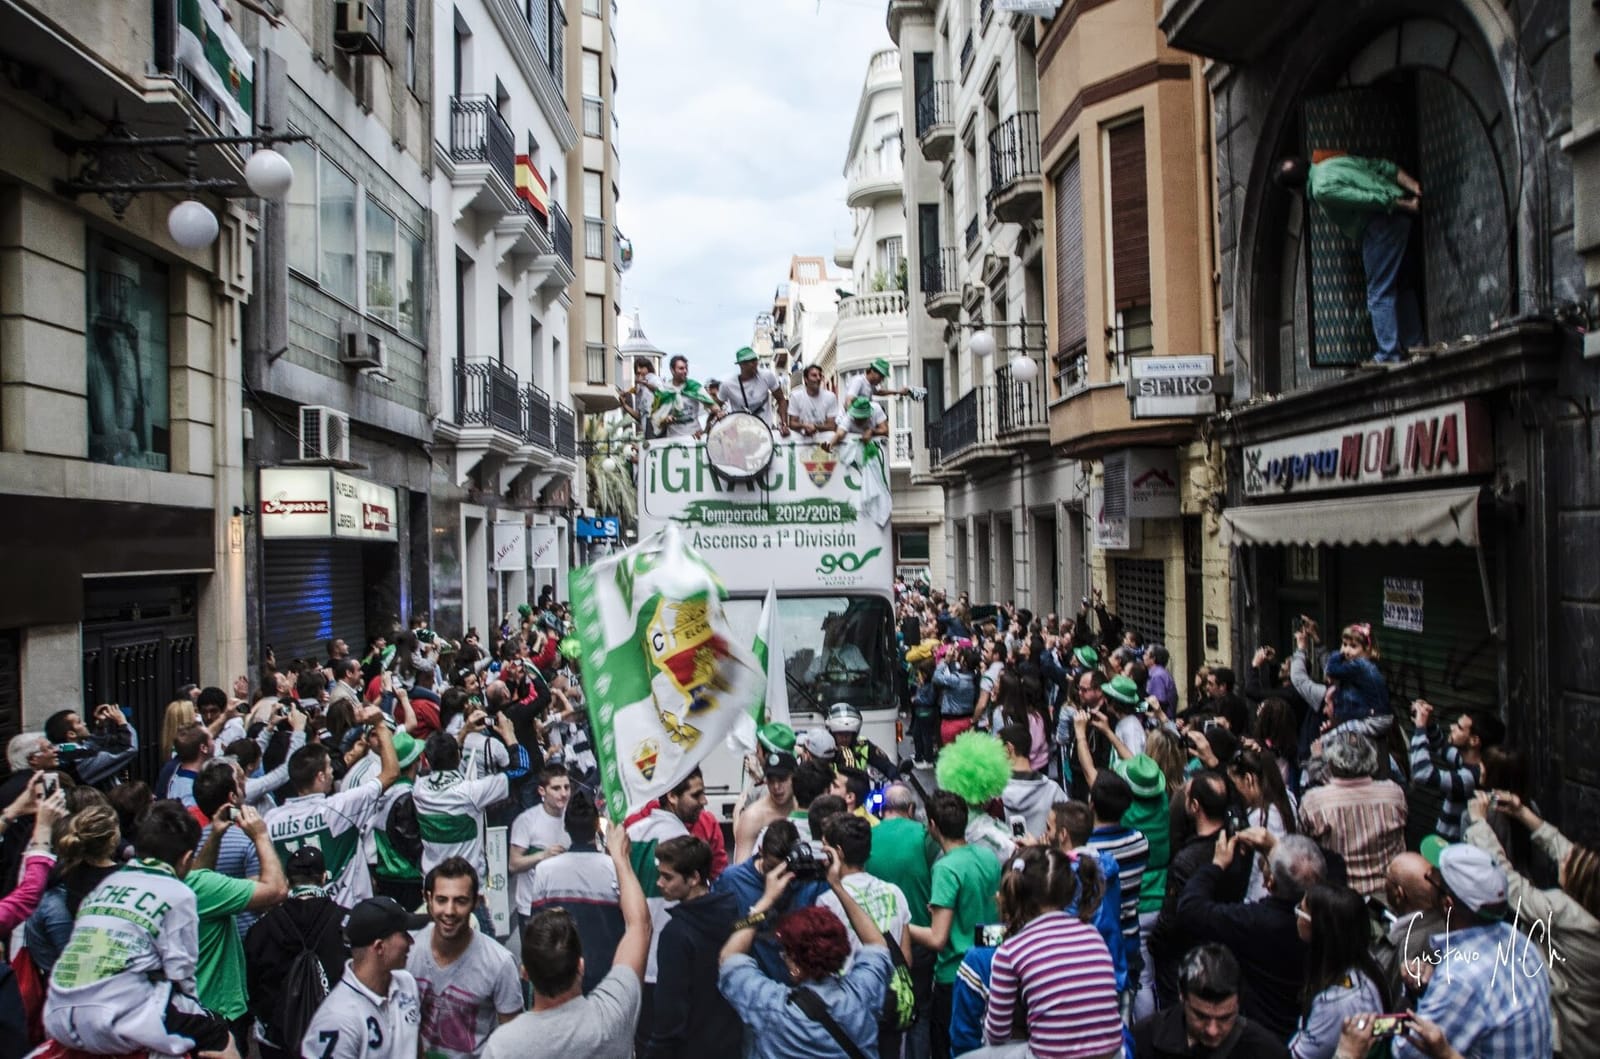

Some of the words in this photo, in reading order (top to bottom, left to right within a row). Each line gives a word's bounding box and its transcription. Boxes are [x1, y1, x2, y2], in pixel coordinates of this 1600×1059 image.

[1140, 376, 1213, 397] SEIKO
[1339, 414, 1460, 481] MOLINA
[701, 506, 768, 523] Temporada
[776, 505, 841, 522] 2012/2013
[693, 530, 757, 549] Ascenso
[762, 534, 771, 548] a
[795, 528, 856, 548] División
[304, 813, 327, 830] GIL
[319, 1030, 339, 1059] 7
